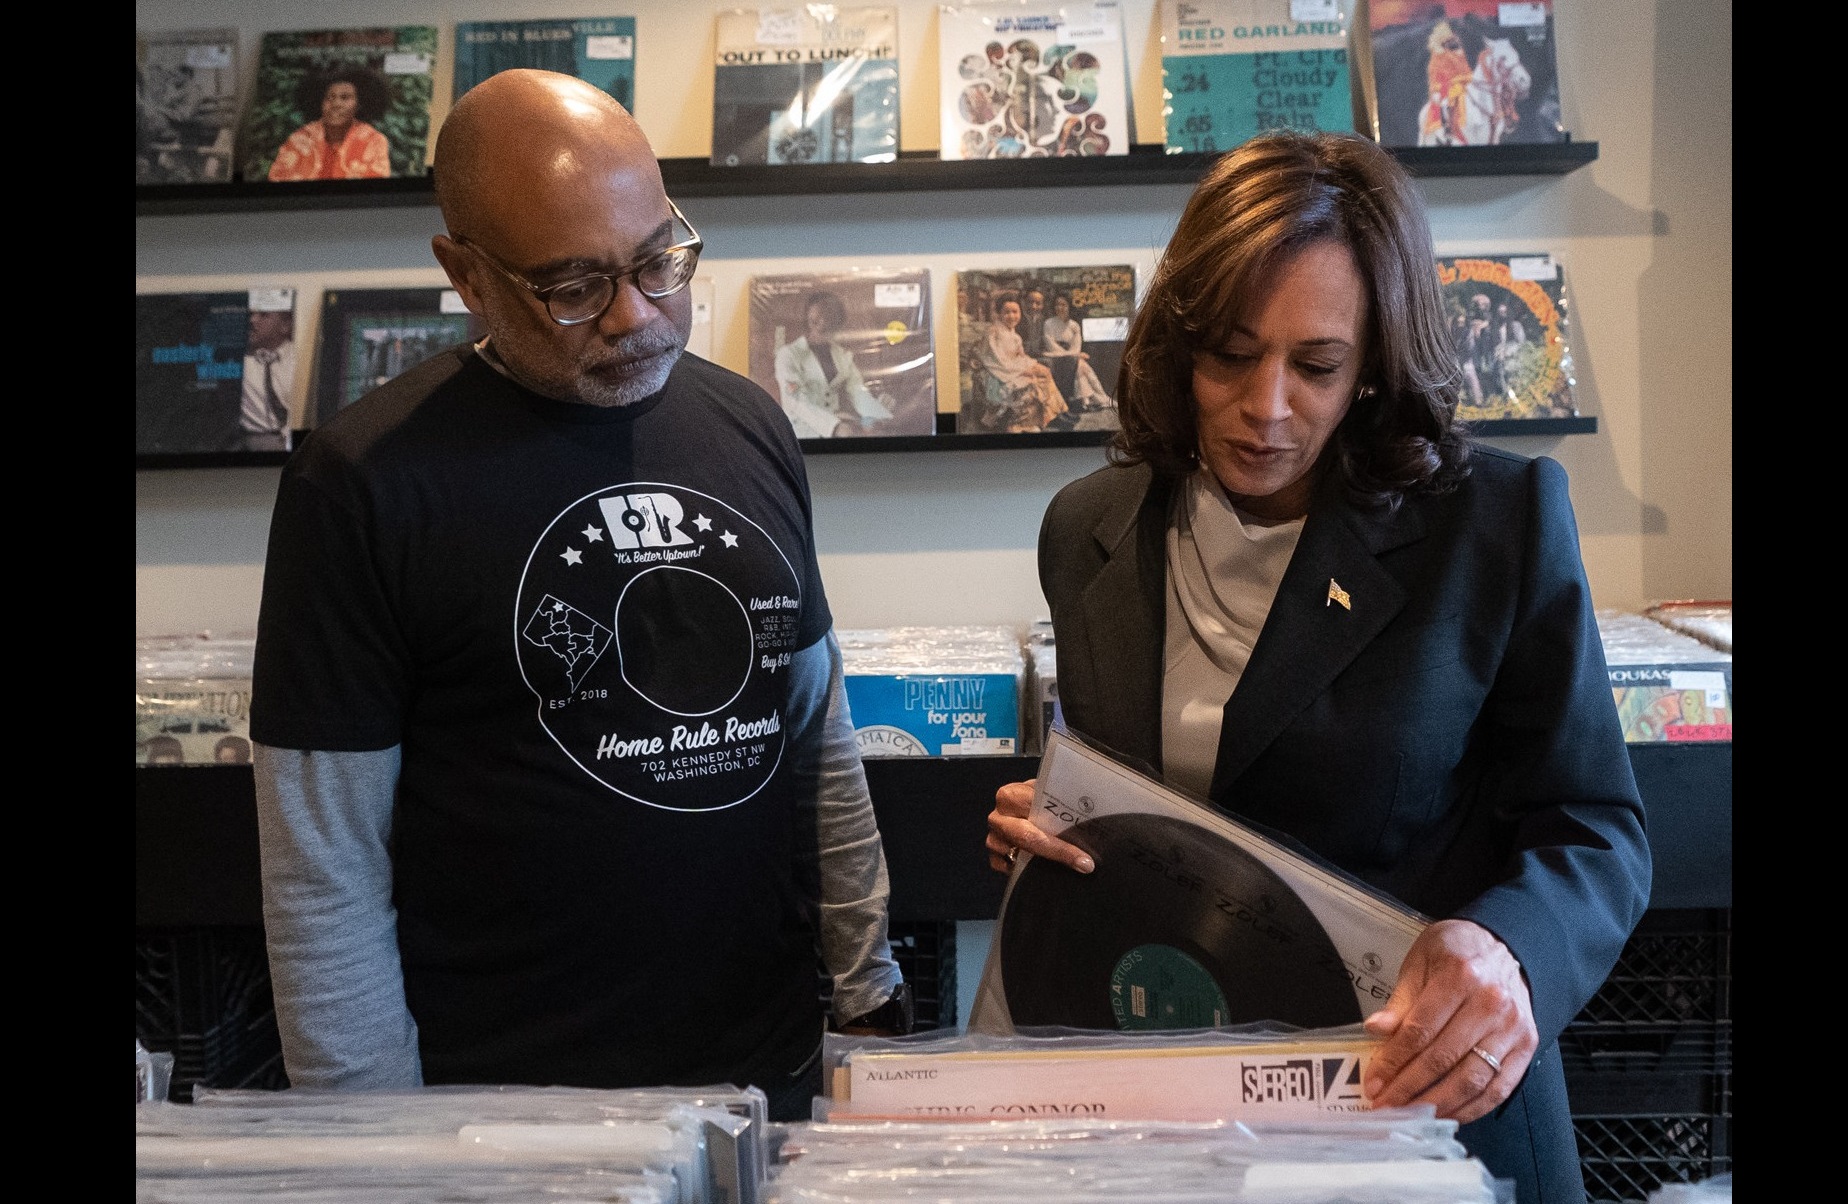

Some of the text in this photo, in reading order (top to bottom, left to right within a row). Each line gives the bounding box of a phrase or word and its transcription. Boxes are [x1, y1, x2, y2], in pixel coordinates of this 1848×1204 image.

[1178, 21, 1343, 41] RED GARLAND
[774, 48, 802, 62] TO
[1254, 68, 1338, 88] Cloudy
[1257, 89, 1323, 109] Clear
[633, 550, 661, 563] Better
[750, 596, 774, 611] Used
[774, 595, 781, 610] &
[761, 654, 777, 674] Buy
[777, 652, 784, 667] &
[580, 689, 608, 701] 2018
[904, 678, 986, 711] PENNY
[927, 710, 987, 729] for your
[596, 708, 781, 761] Home Rule Records
[857, 731, 914, 756] MAICA
[640, 743, 766, 773] 702 KENNEDY ST NW
[654, 755, 761, 783] WASHINGTON, DC
[1112, 950, 1143, 995] ARTISTS
[866, 1069, 938, 1081] ATLANTIC
